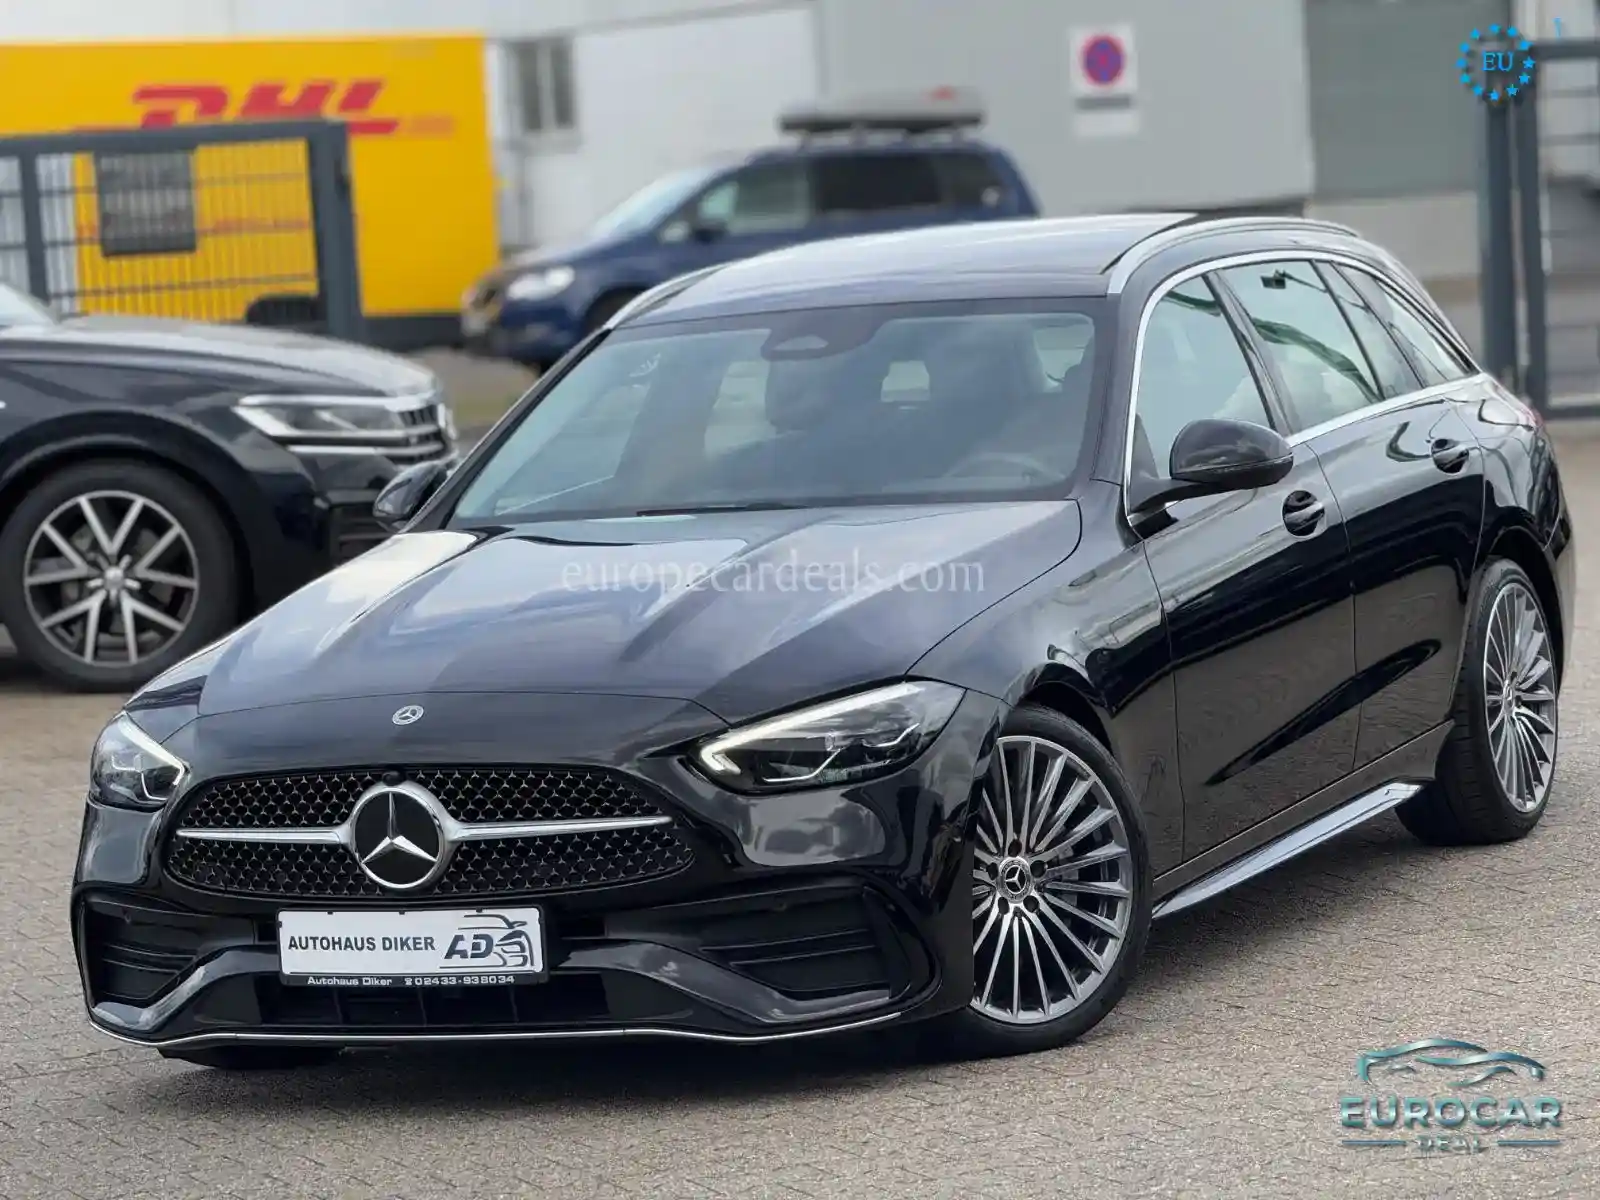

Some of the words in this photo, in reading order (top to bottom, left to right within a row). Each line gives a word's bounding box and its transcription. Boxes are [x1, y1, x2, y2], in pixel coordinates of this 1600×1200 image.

[131, 79, 399, 136] DHL
[288, 936, 376, 951] AUTOHAUS
[382, 936, 436, 951] DIKER
[307, 976, 359, 986] Autohaus
[362, 976, 393, 986] Diker
